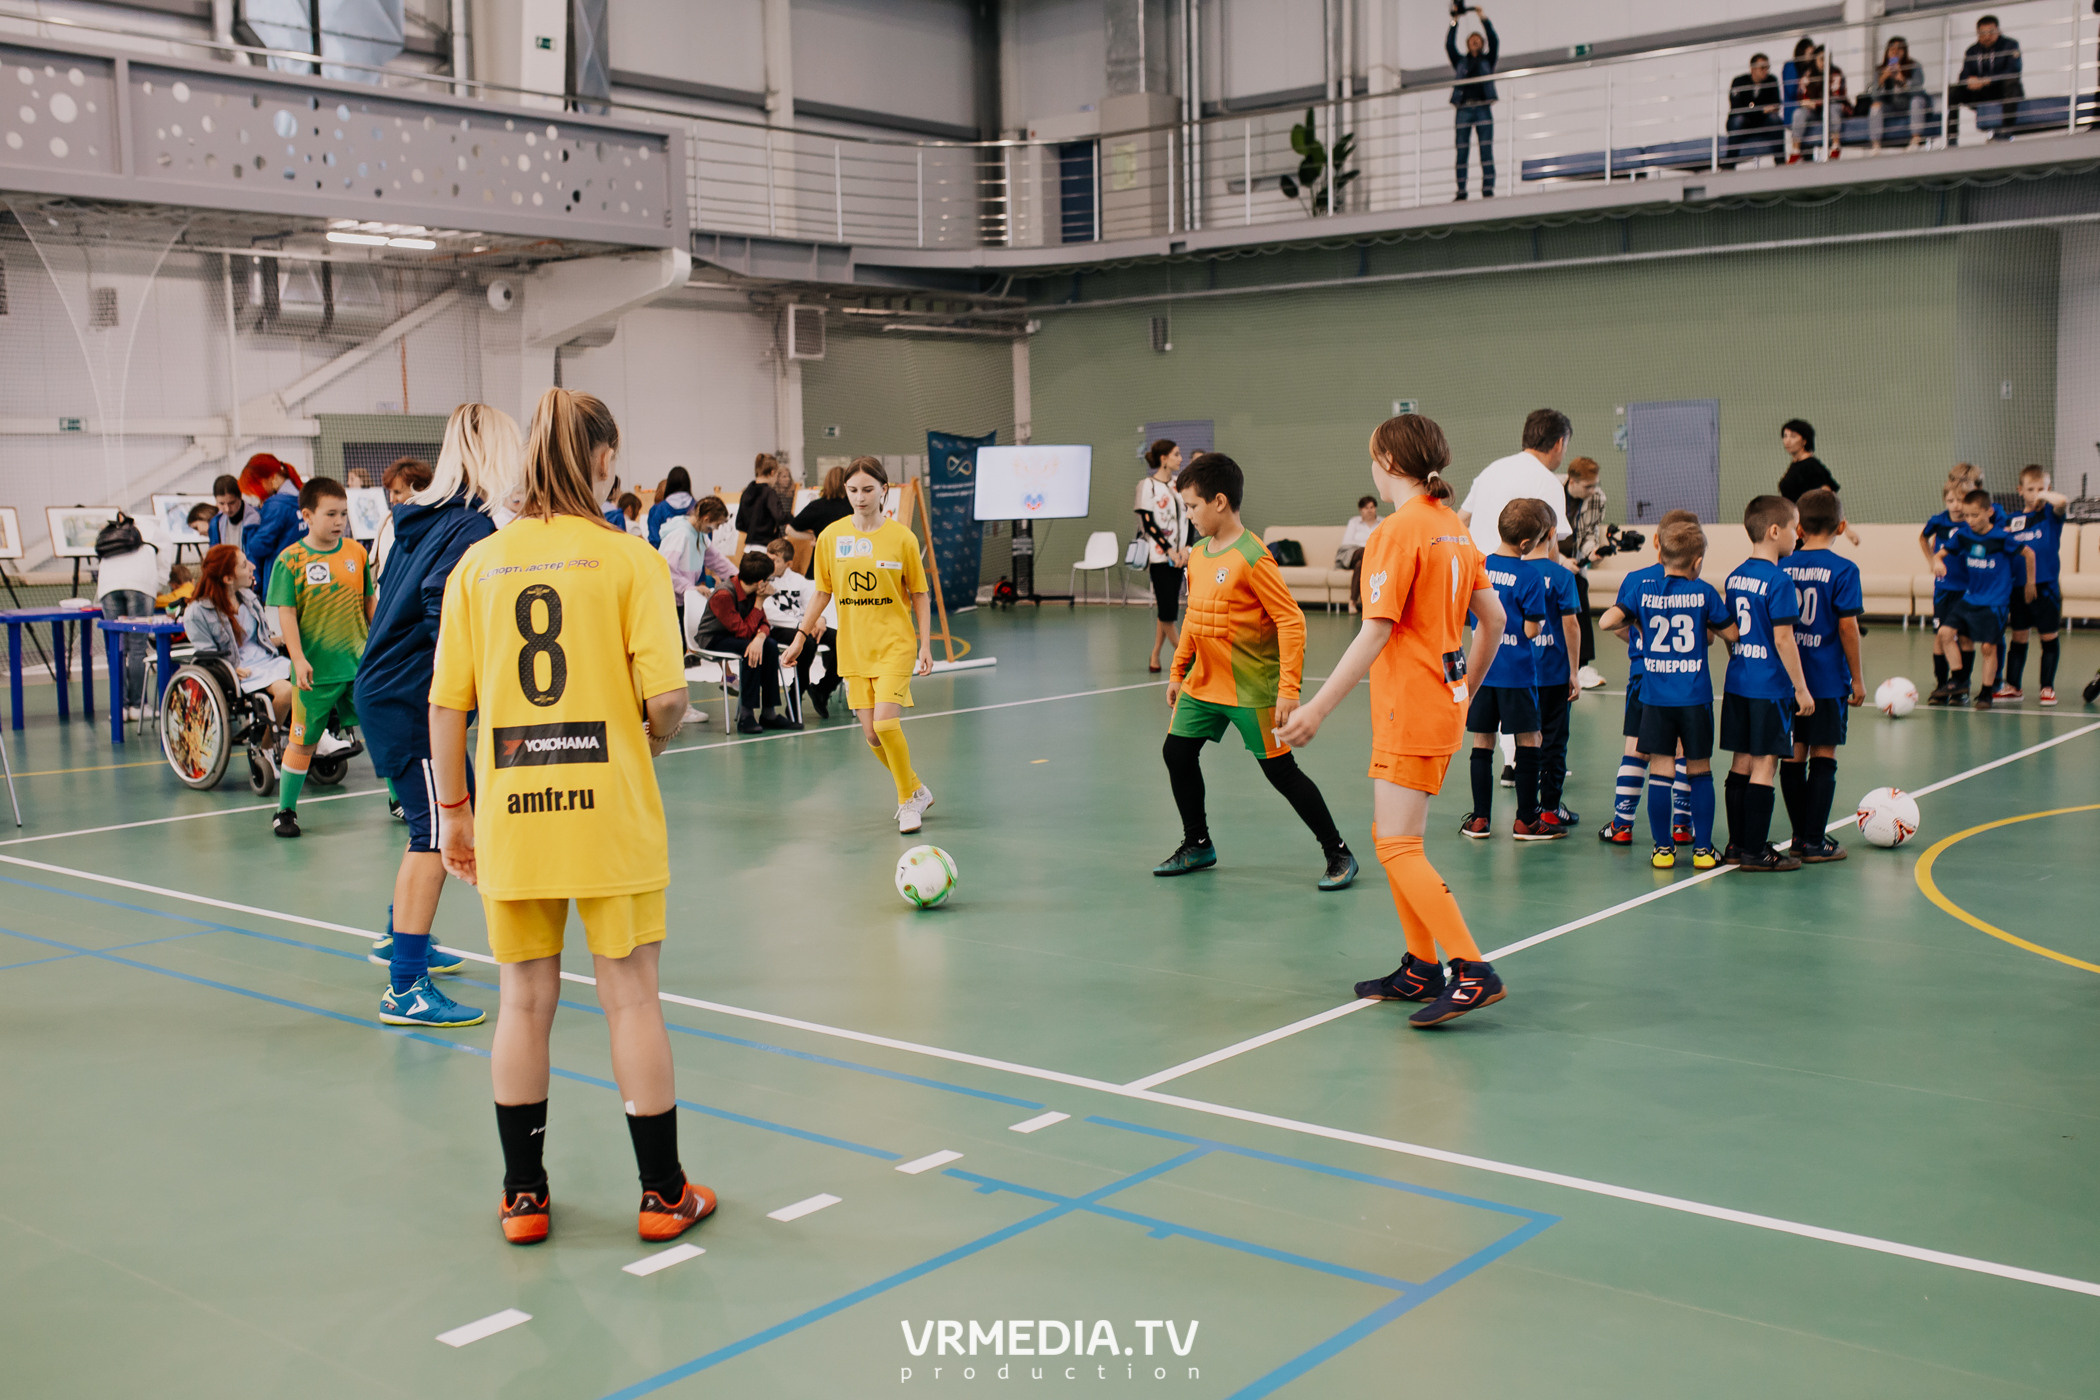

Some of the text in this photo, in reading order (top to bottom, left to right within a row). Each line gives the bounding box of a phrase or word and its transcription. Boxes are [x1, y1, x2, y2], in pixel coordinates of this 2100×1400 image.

[1641, 593, 1705, 609] РЕШЕТНИКОВ
[1736, 596, 1752, 636] 6
[515, 584, 568, 707] 8
[1649, 614, 1696, 653] 23
[524, 736, 600, 753] YOKOHAMA
[507, 787, 595, 815] amfr.ru
